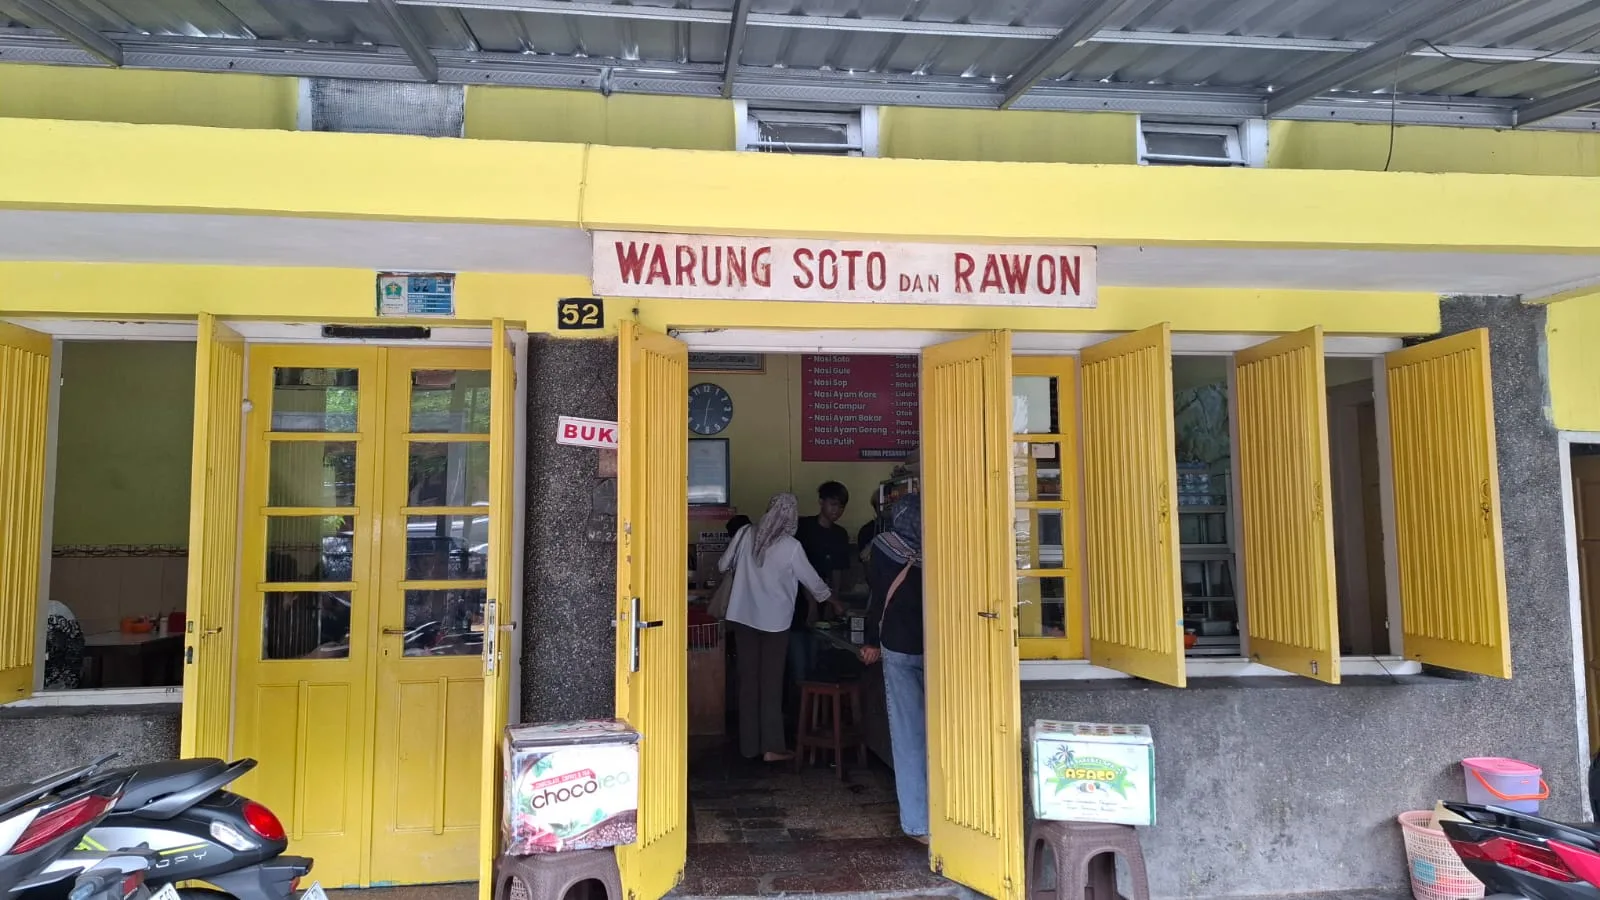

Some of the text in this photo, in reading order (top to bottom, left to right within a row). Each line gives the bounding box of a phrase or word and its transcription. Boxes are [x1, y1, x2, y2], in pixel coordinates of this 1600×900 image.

[614, 241, 1081, 296] WARUNG SOTO DAN RAWON
[561, 303, 599, 325] 52
[813, 355, 850, 363] Nasi Soto
[814, 367, 850, 375] Nasi Gule
[833, 379, 848, 388] Sop
[814, 390, 877, 400] Nasi Ayam Kare
[833, 402, 866, 412] Campur
[833, 414, 857, 424] Ayam
[564, 423, 618, 443] BUK
[833, 426, 857, 436] Ayam
[859, 426, 888, 436] Goreng
[814, 437, 855, 445] Nasi Putih
